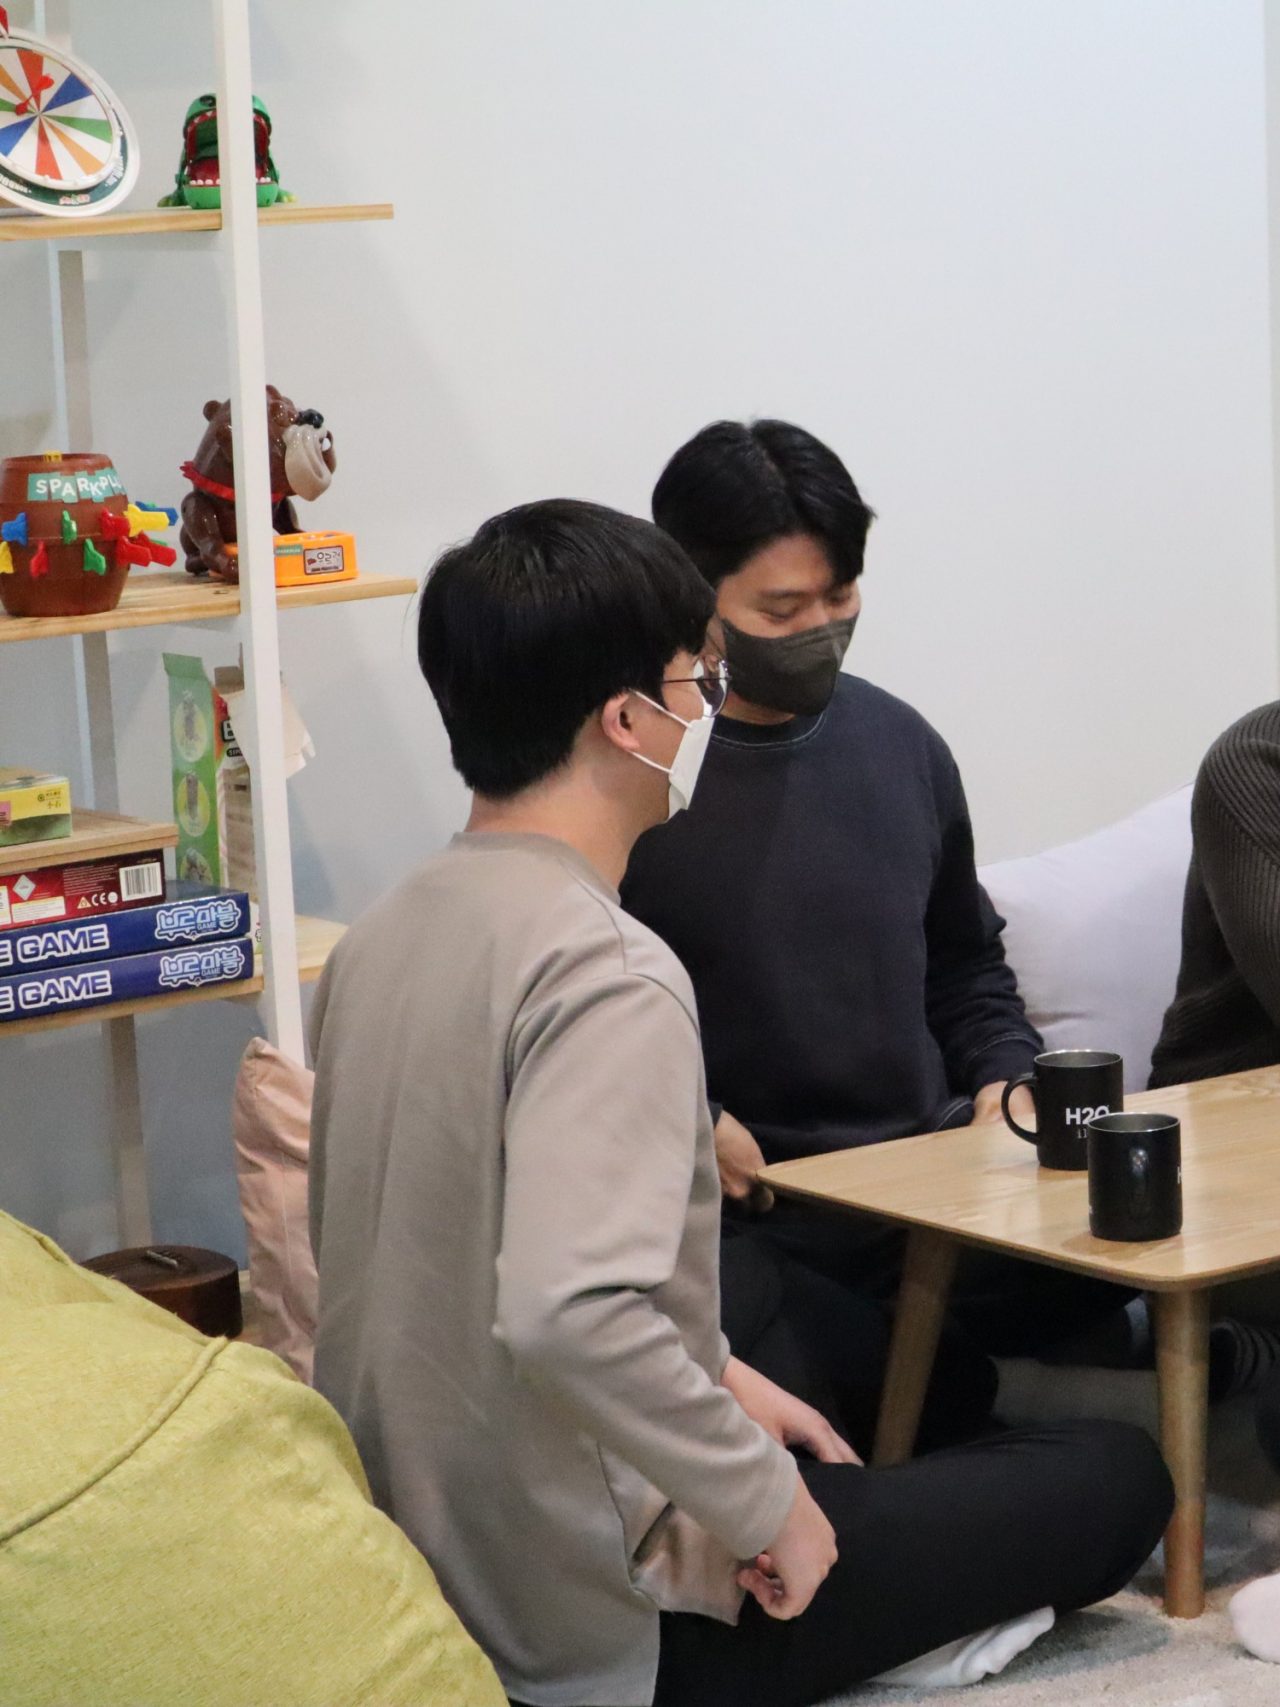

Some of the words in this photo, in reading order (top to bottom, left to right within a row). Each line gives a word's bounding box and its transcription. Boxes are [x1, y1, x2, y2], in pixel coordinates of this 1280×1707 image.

[155, 899, 241, 940] 부루마불
[17, 924, 109, 963] GAME
[159, 945, 245, 987] 부루마불
[18, 970, 112, 1009] GAME
